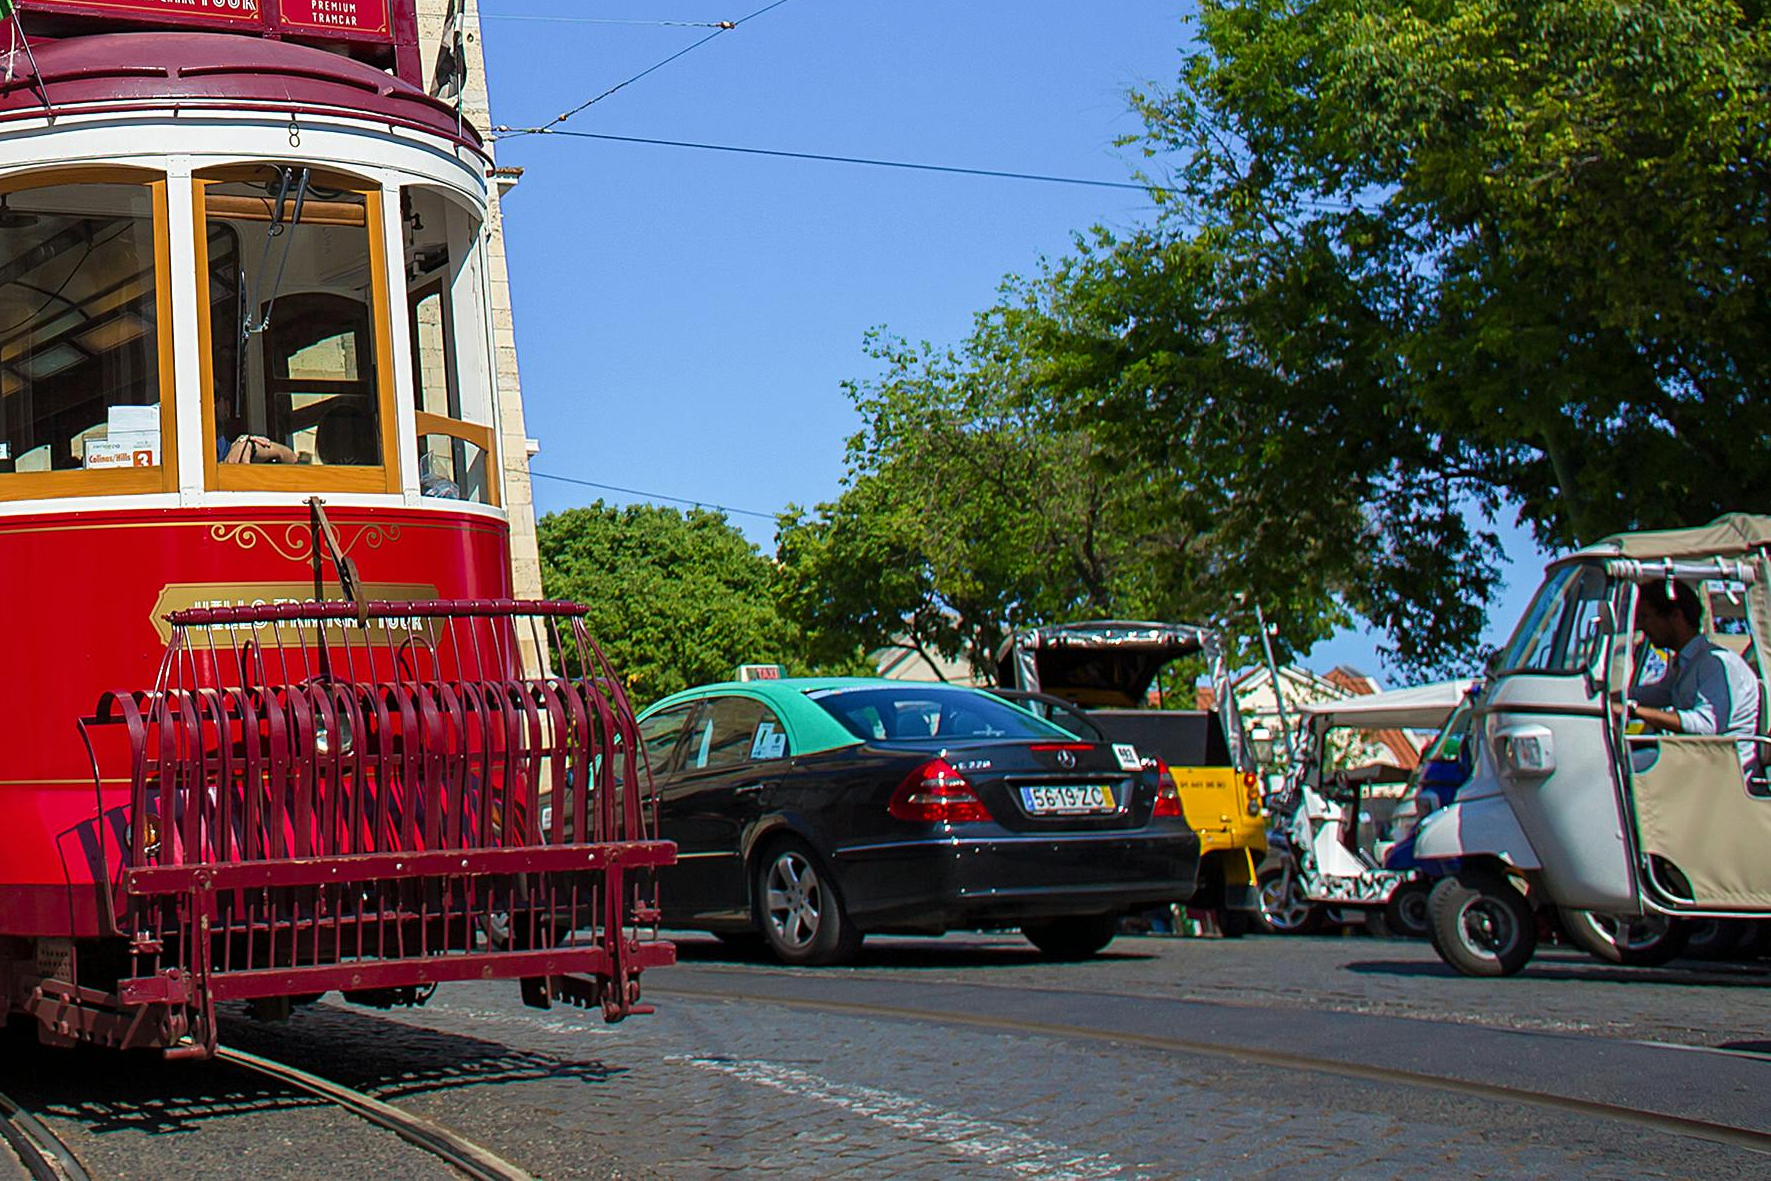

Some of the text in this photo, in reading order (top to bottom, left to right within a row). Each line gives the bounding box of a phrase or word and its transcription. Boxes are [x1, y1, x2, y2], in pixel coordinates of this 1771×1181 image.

[311, 0, 356, 14] PREMIUM
[312, 12, 357, 26] TRAMCAR
[288, 122, 301, 148] 8
[137, 453, 149, 467] 3
[757, 667, 778, 680] TAXI
